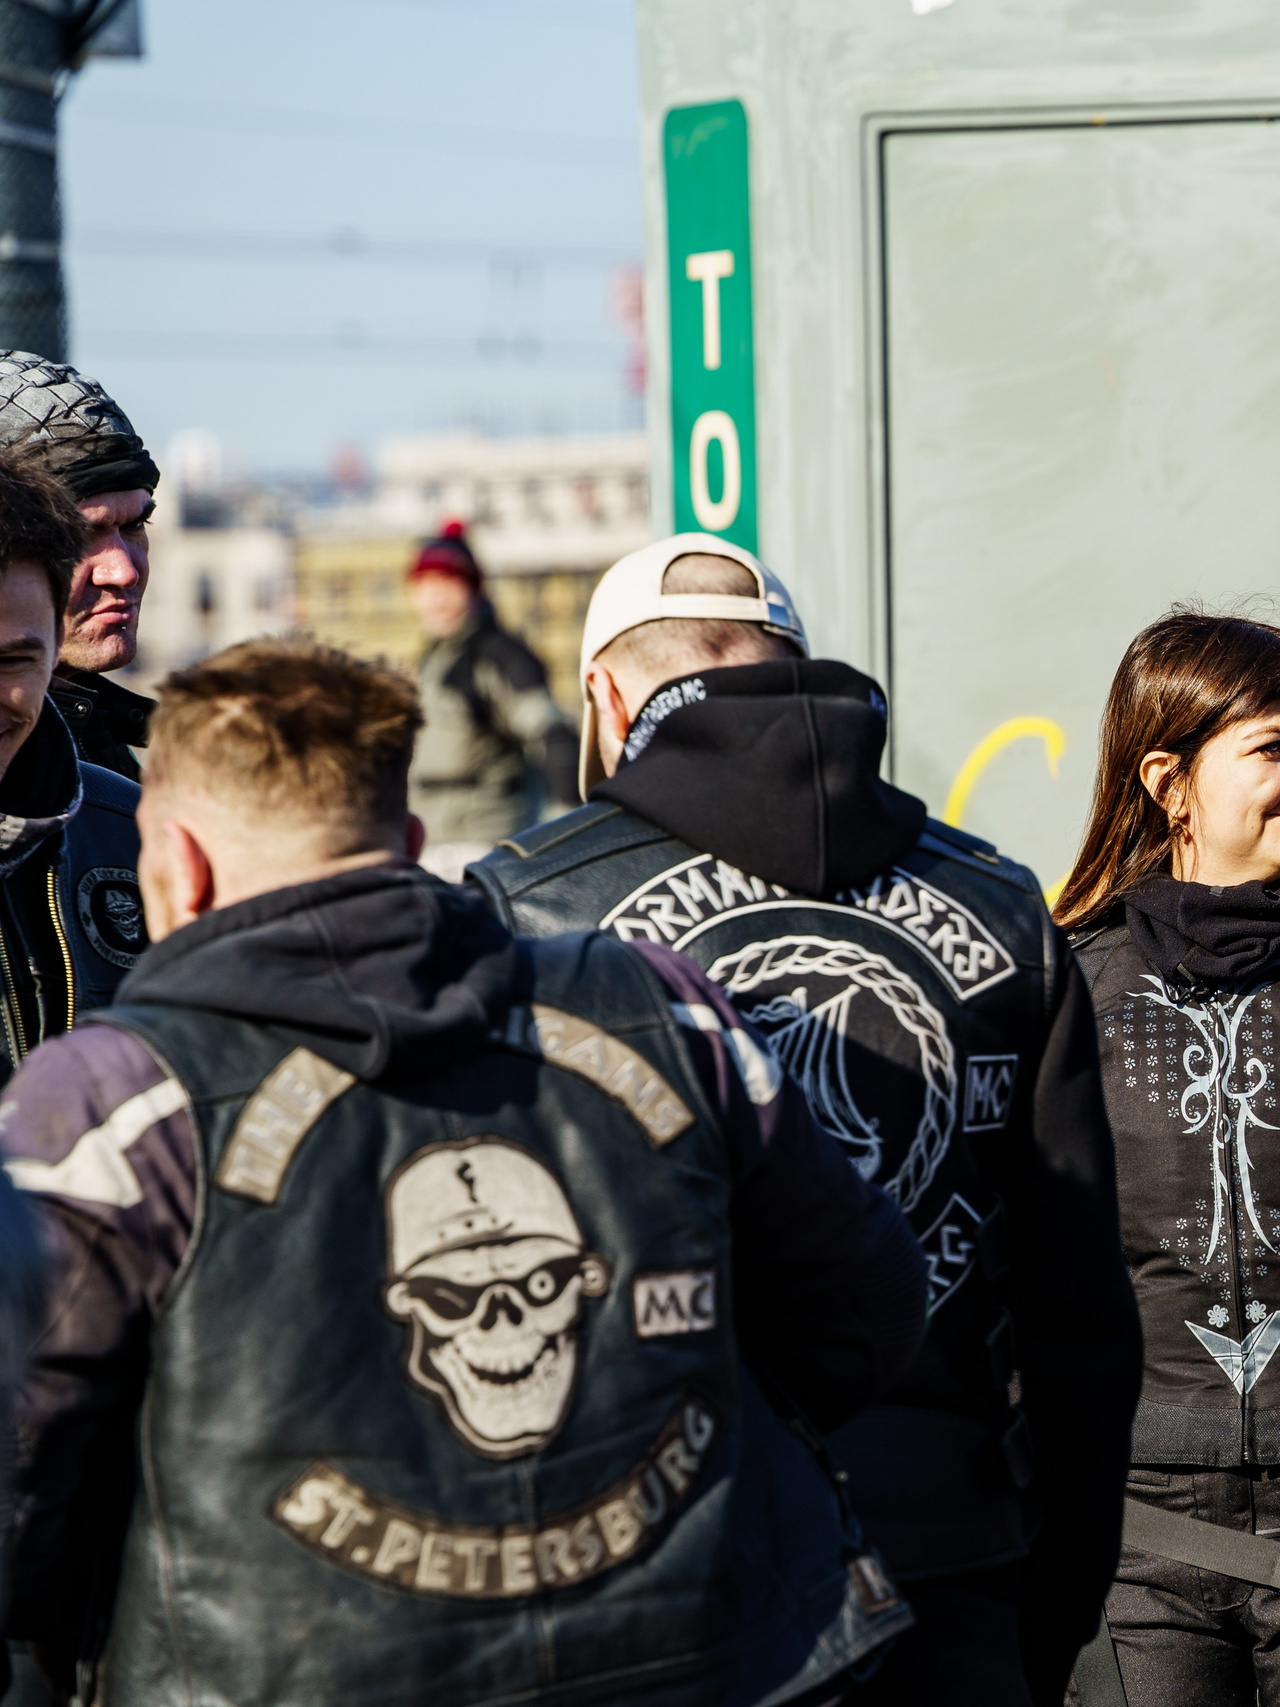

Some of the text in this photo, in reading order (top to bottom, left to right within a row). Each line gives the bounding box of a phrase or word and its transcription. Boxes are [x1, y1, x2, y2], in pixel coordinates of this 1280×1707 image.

[224, 1068, 324, 1188] THE
[968, 1064, 1012, 1121] MC
[643, 1281, 714, 1326] MC
[282, 1404, 715, 1593] ST.PETERSBURG
